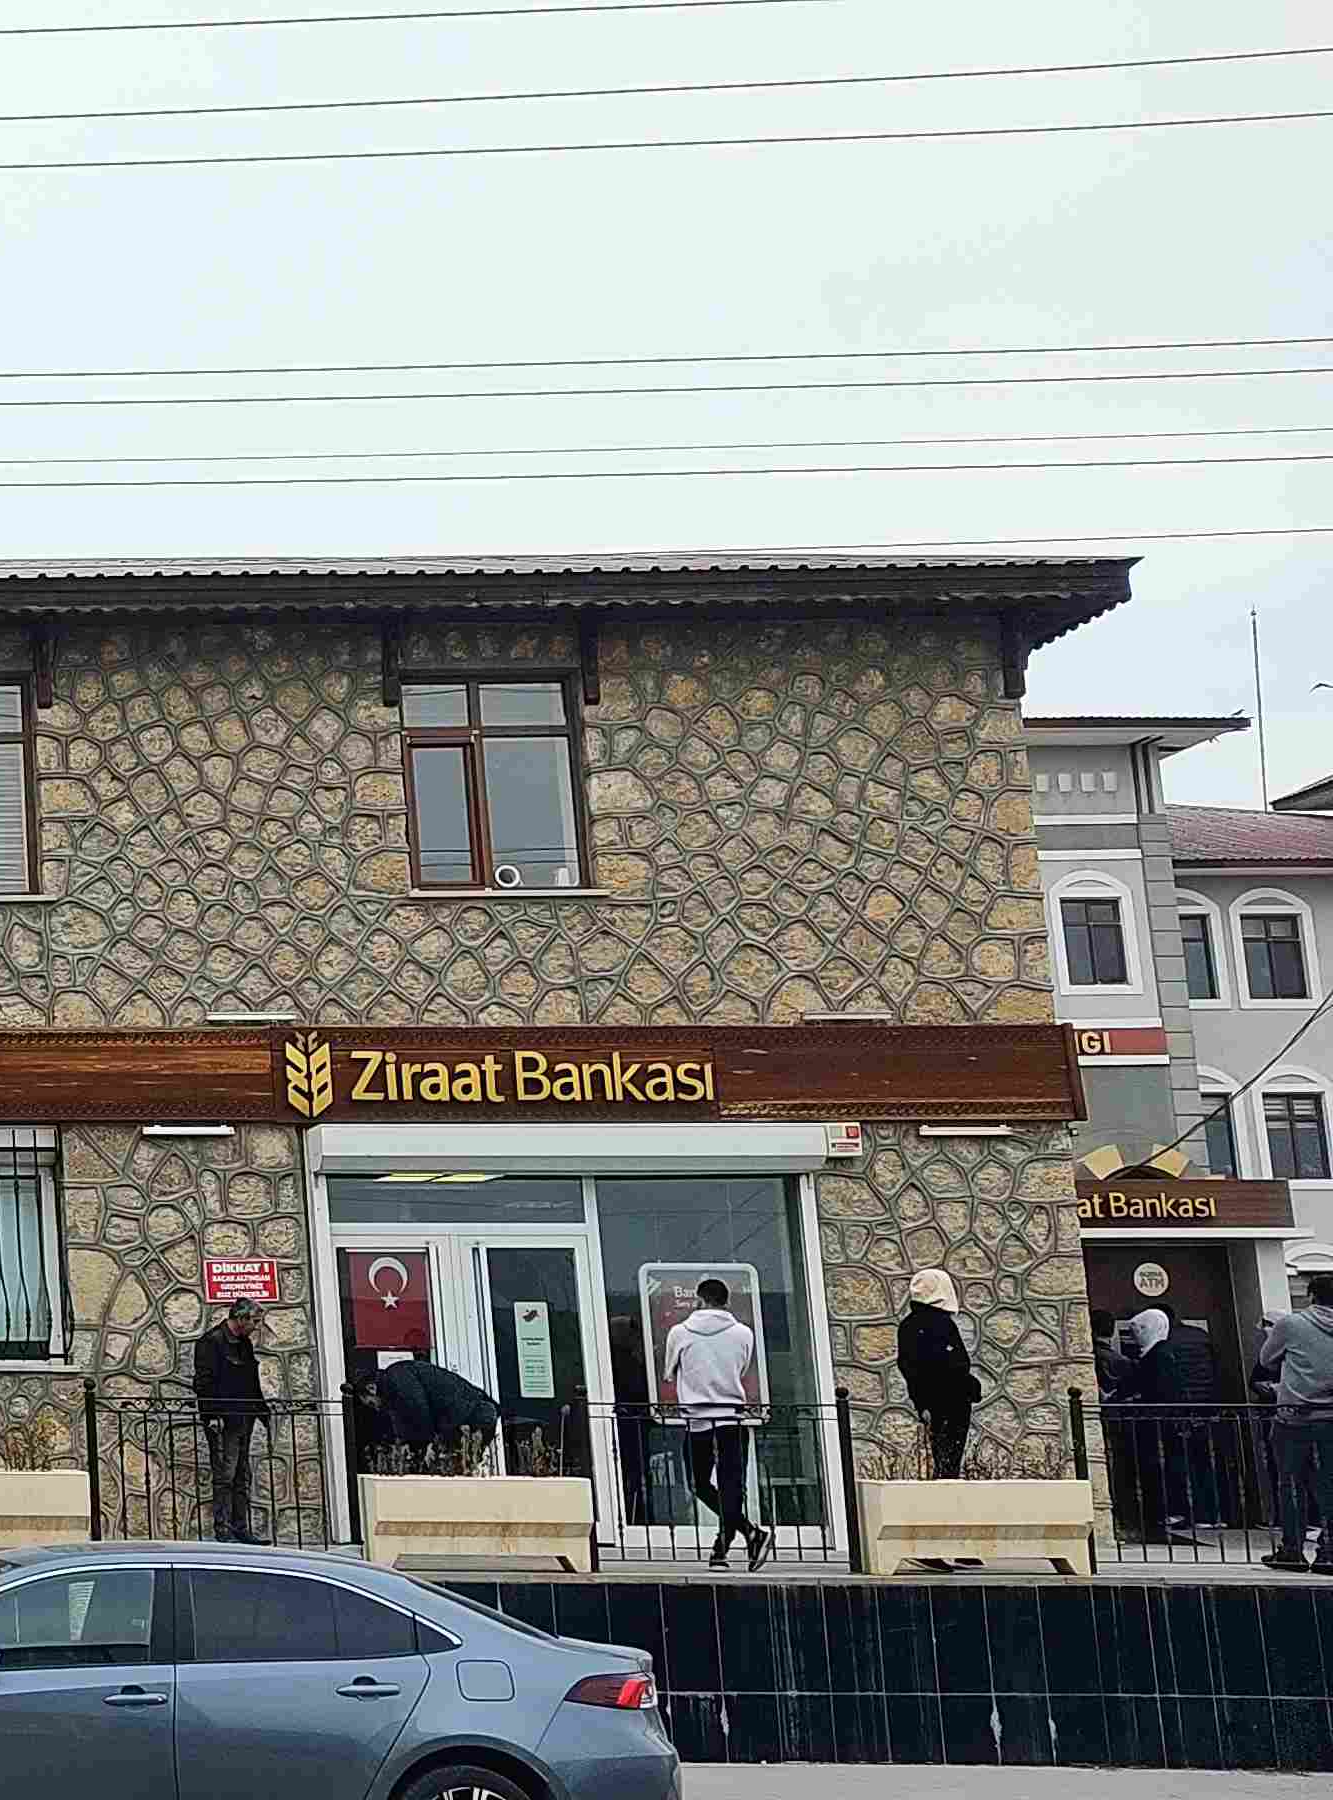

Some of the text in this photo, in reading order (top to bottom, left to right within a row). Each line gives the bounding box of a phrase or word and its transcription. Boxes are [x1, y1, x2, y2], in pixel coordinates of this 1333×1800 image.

[350, 1050, 715, 1102] Ziraat Bankası
[1108, 1191, 1217, 1218] Bankası
